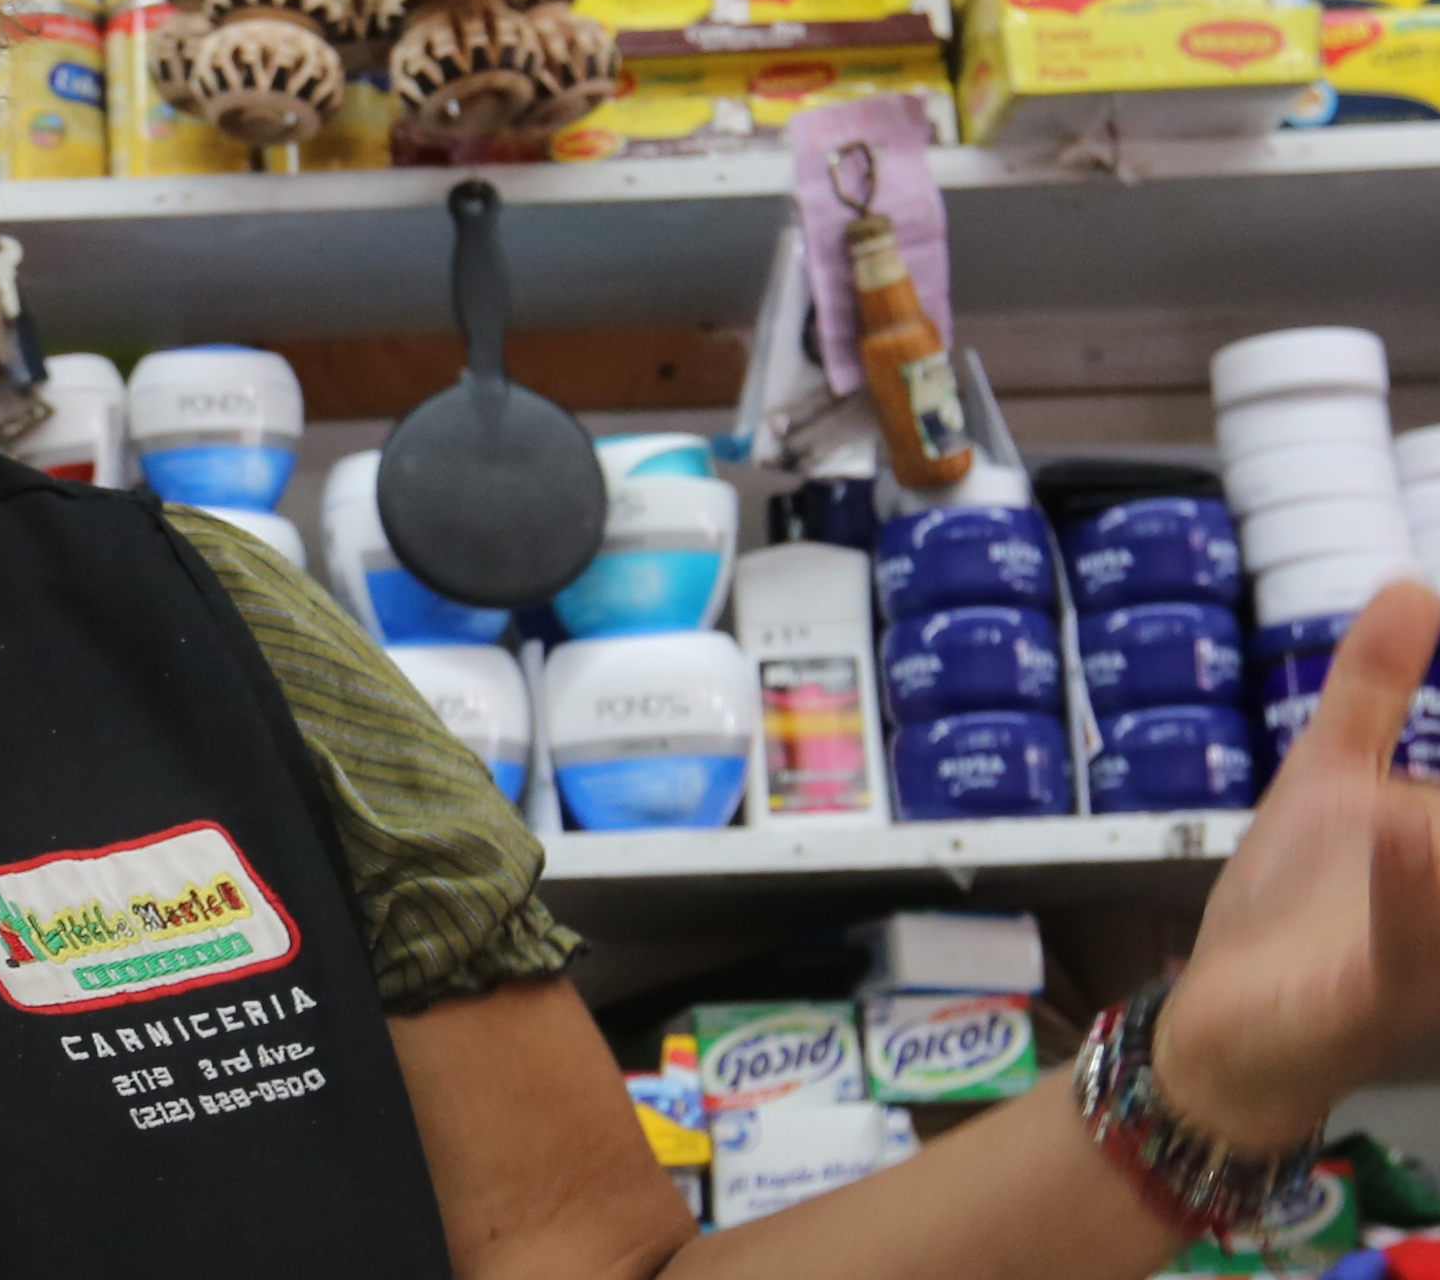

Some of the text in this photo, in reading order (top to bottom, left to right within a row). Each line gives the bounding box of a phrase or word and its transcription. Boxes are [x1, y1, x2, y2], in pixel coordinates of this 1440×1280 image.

[61, 986, 318, 1062] CARNICERIA
[112, 1066, 175, 1097] 2119
[129, 1097, 196, 1131] (212)
